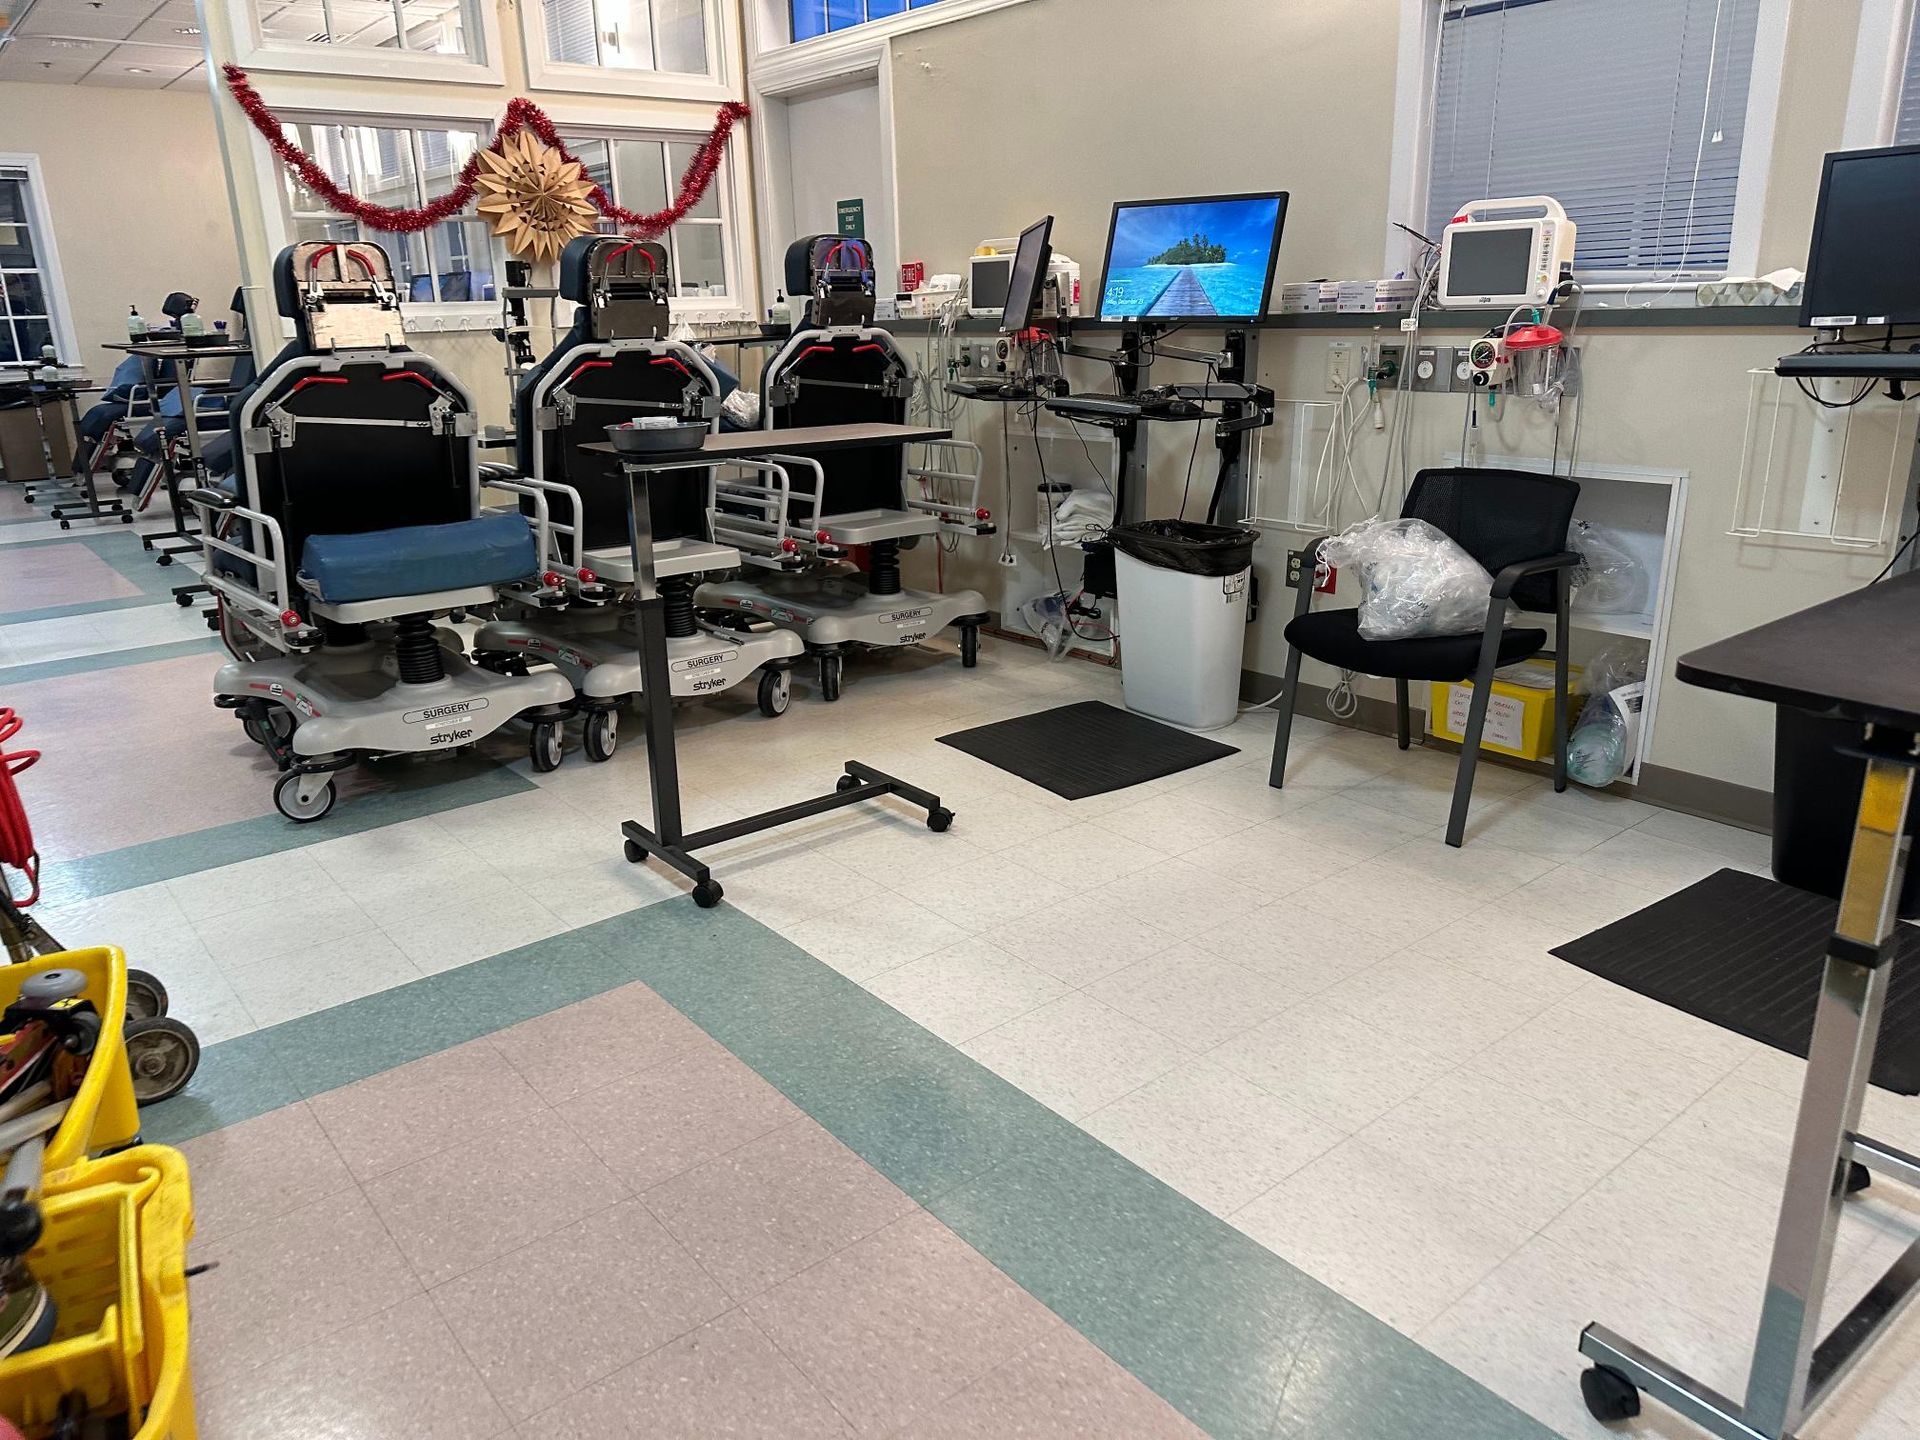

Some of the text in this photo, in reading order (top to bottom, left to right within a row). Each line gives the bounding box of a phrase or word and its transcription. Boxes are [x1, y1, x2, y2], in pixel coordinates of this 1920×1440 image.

[838, 206, 861, 214] EMERGENCY
[902, 268, 915, 281] FIRE
[1106, 286, 1124, 298] 4:19
[891, 609, 921, 621] SURGERY
[900, 632, 927, 643] stryker
[687, 654, 724, 669] SURGERY
[693, 677, 727, 691] stryker
[423, 702, 470, 719] SURGERY
[430, 729, 473, 745] stryker
